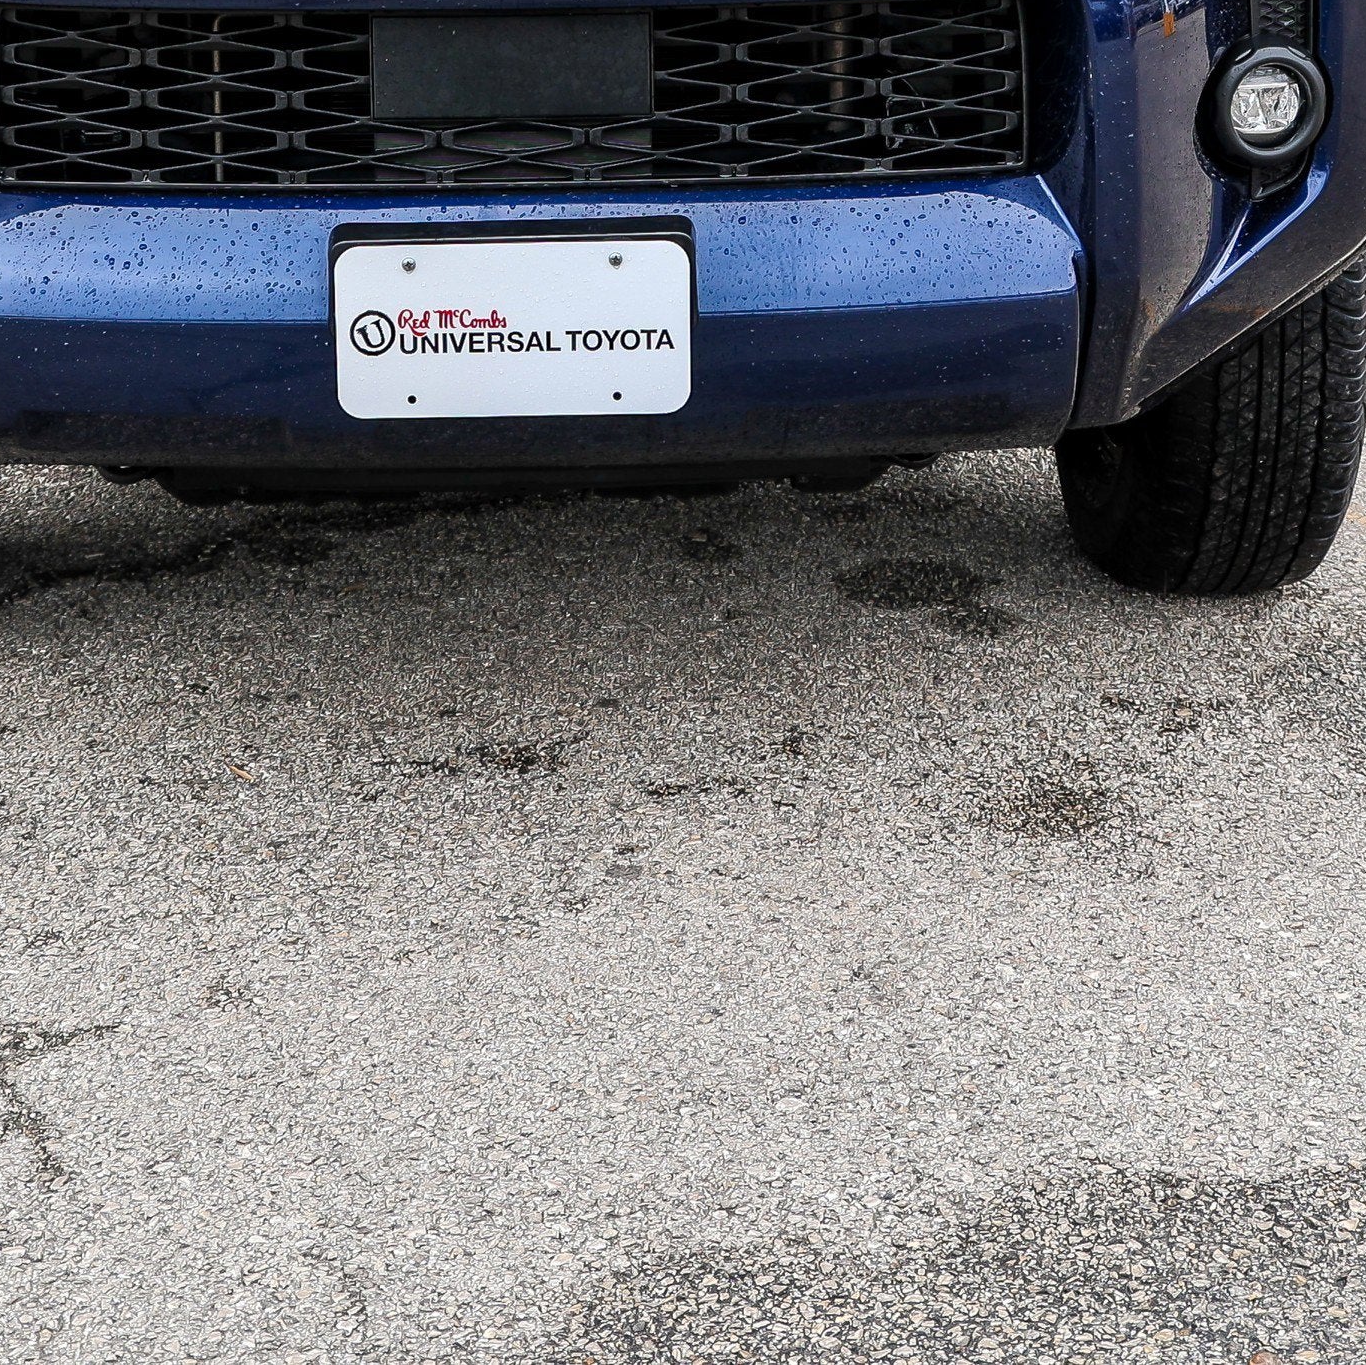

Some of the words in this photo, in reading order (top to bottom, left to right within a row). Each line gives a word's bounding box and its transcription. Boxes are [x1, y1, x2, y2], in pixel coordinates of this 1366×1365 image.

[397, 308, 430, 337] Red
[433, 309, 508, 330] McCombs
[398, 329, 563, 355] UNIVERSAL
[565, 328, 676, 352] TOYOTA
